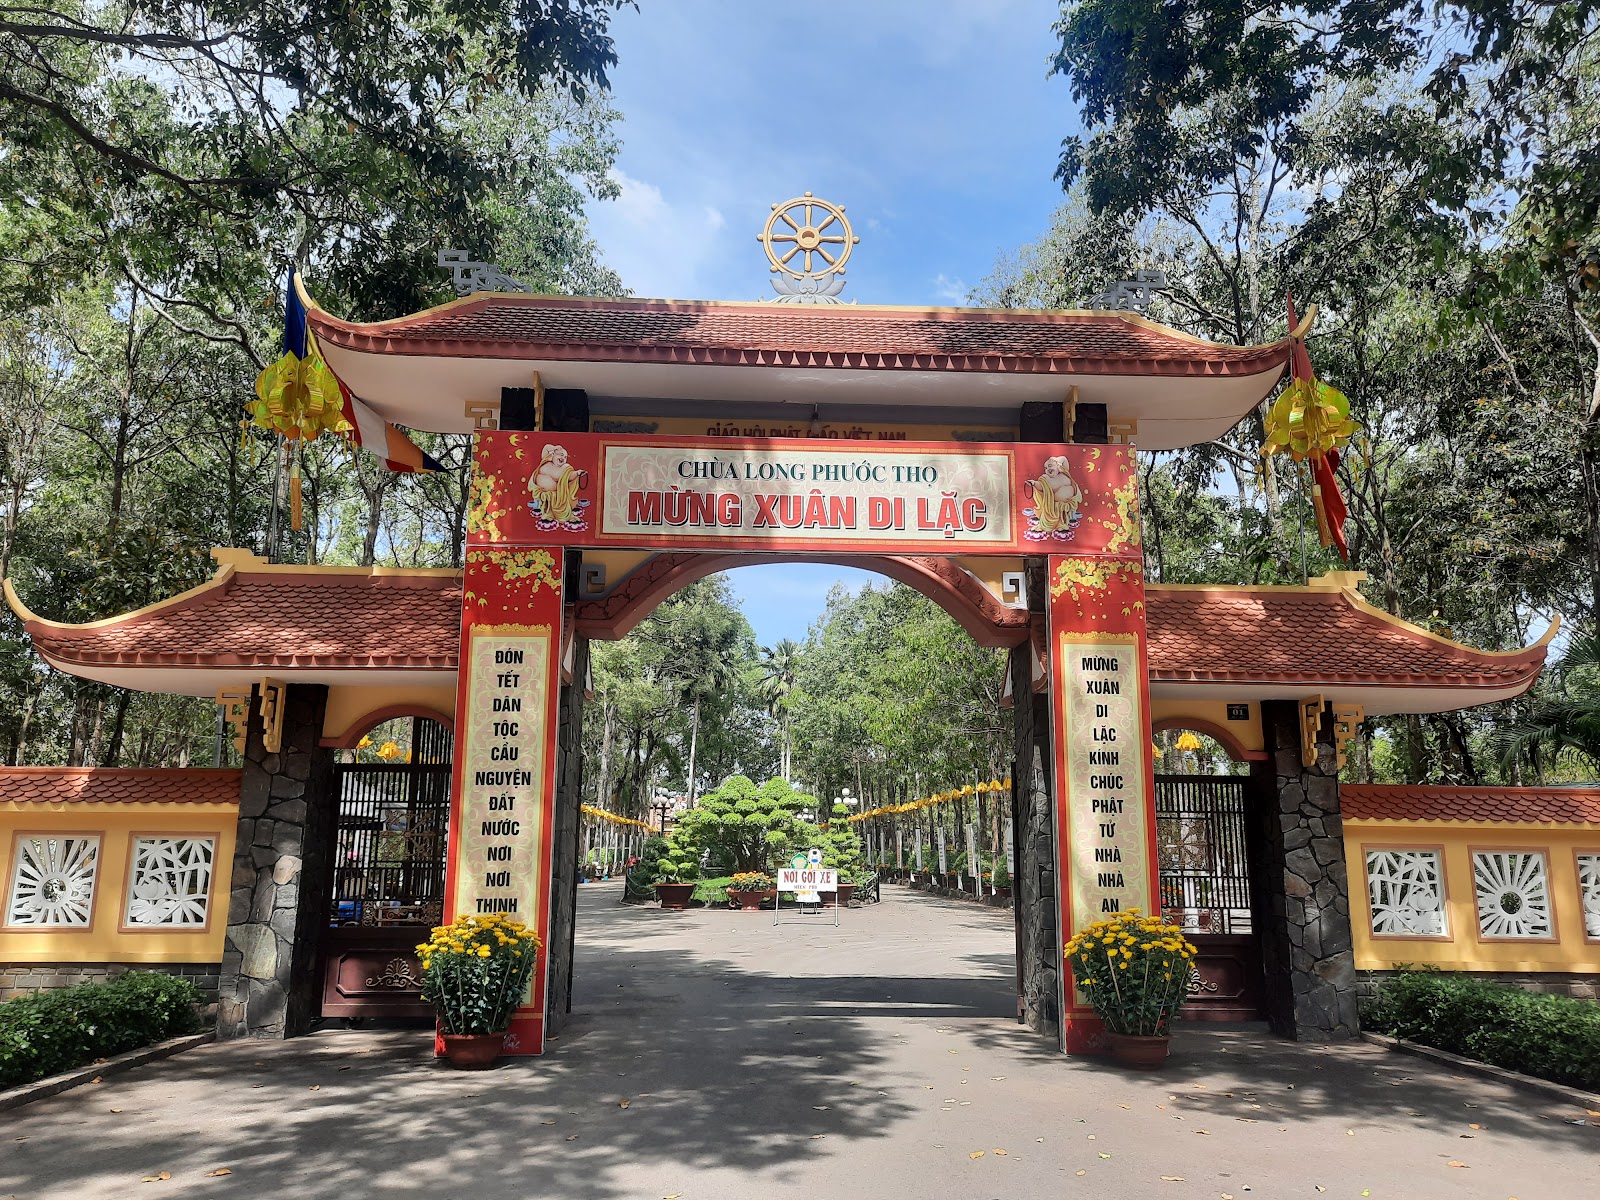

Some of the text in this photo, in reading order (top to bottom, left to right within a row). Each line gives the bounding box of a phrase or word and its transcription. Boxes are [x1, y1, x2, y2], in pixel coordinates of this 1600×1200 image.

[707, 422, 740, 436] GIÁO
[806, 425, 839, 439] GÁO
[878, 431, 906, 440] NAM
[677, 457, 938, 488] CHÙA LONG PHƯỚC THỌ
[627, 485, 988, 538] MỪNG XUÂN DI LẶC
[475, 648, 531, 916] ĐÓN TẾT DÂN TỘC CẦU NGUYỆN ĐẤT NƯỚC NƠI NƠI THỊNH
[1082, 655, 1125, 913] MỪNG XUÂN DI LẶC KÍNH CHÚC PHẬT TỬ NHÀ NHÀ AN
[820, 871, 831, 884] XE
